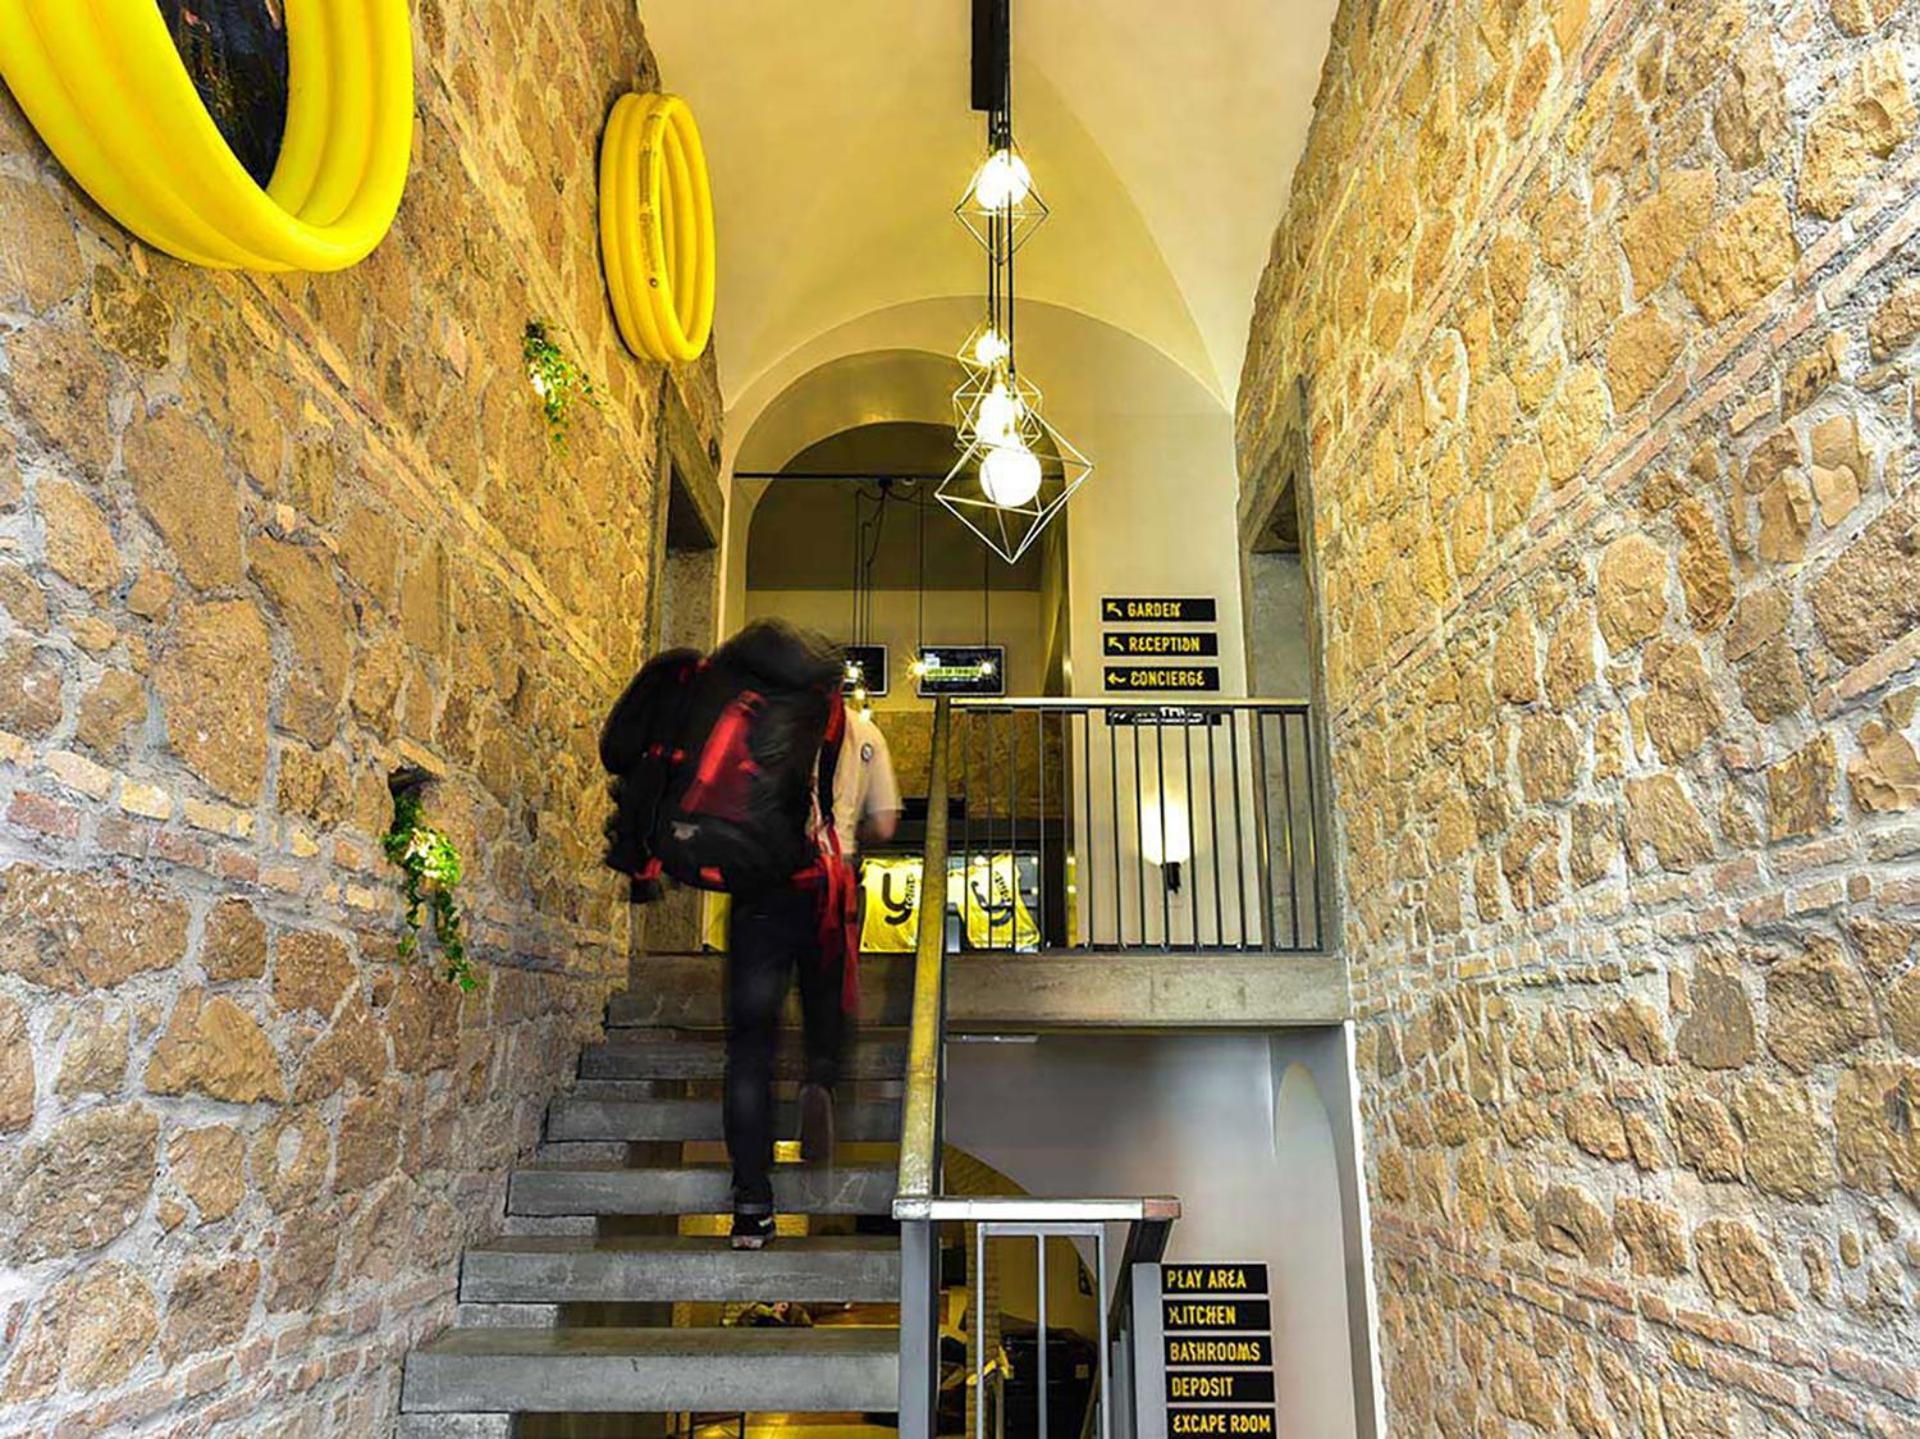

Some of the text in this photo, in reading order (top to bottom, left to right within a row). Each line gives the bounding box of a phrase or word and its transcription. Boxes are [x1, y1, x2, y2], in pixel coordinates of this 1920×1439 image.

[1128, 636, 1200, 652] RECEPTION
[1130, 670, 1205, 687] CONCIERGE
[1167, 1269, 1247, 1289] PLAY AREA
[1168, 1305, 1236, 1325] KITCHEN
[1170, 1341, 1261, 1361] BATHROOMS
[1171, 1376, 1234, 1397] DEPOSIT
[1230, 1414, 1271, 1433] ROOM
